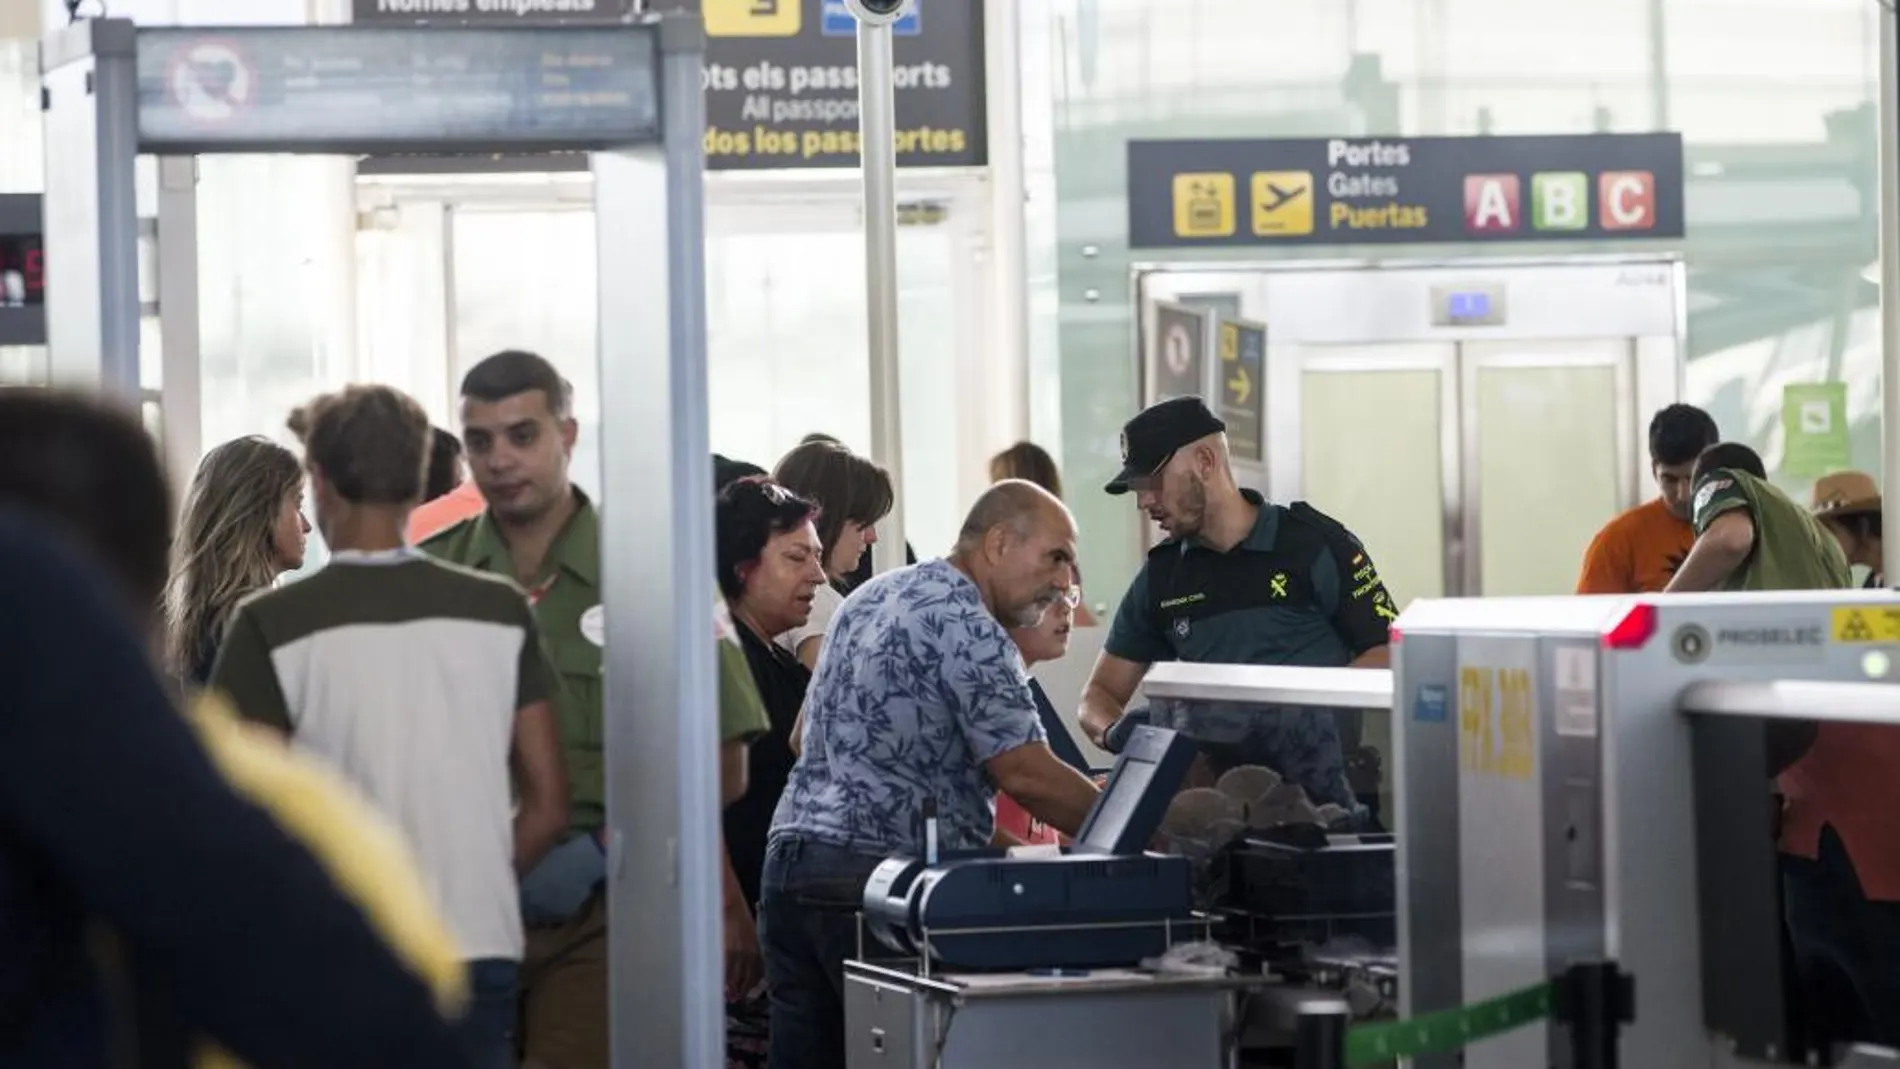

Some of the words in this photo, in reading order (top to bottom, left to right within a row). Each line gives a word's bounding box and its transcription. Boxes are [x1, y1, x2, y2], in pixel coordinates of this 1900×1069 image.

[743, 60, 786, 90] els
[741, 94, 771, 120] All
[754, 124, 798, 154] los
[1328, 139, 1410, 167] Portes
[1327, 172, 1398, 197] Gates
[1474, 179, 1511, 227] A
[1542, 176, 1577, 223] B
[1608, 175, 1645, 225] C
[1330, 202, 1428, 230] Puertas
